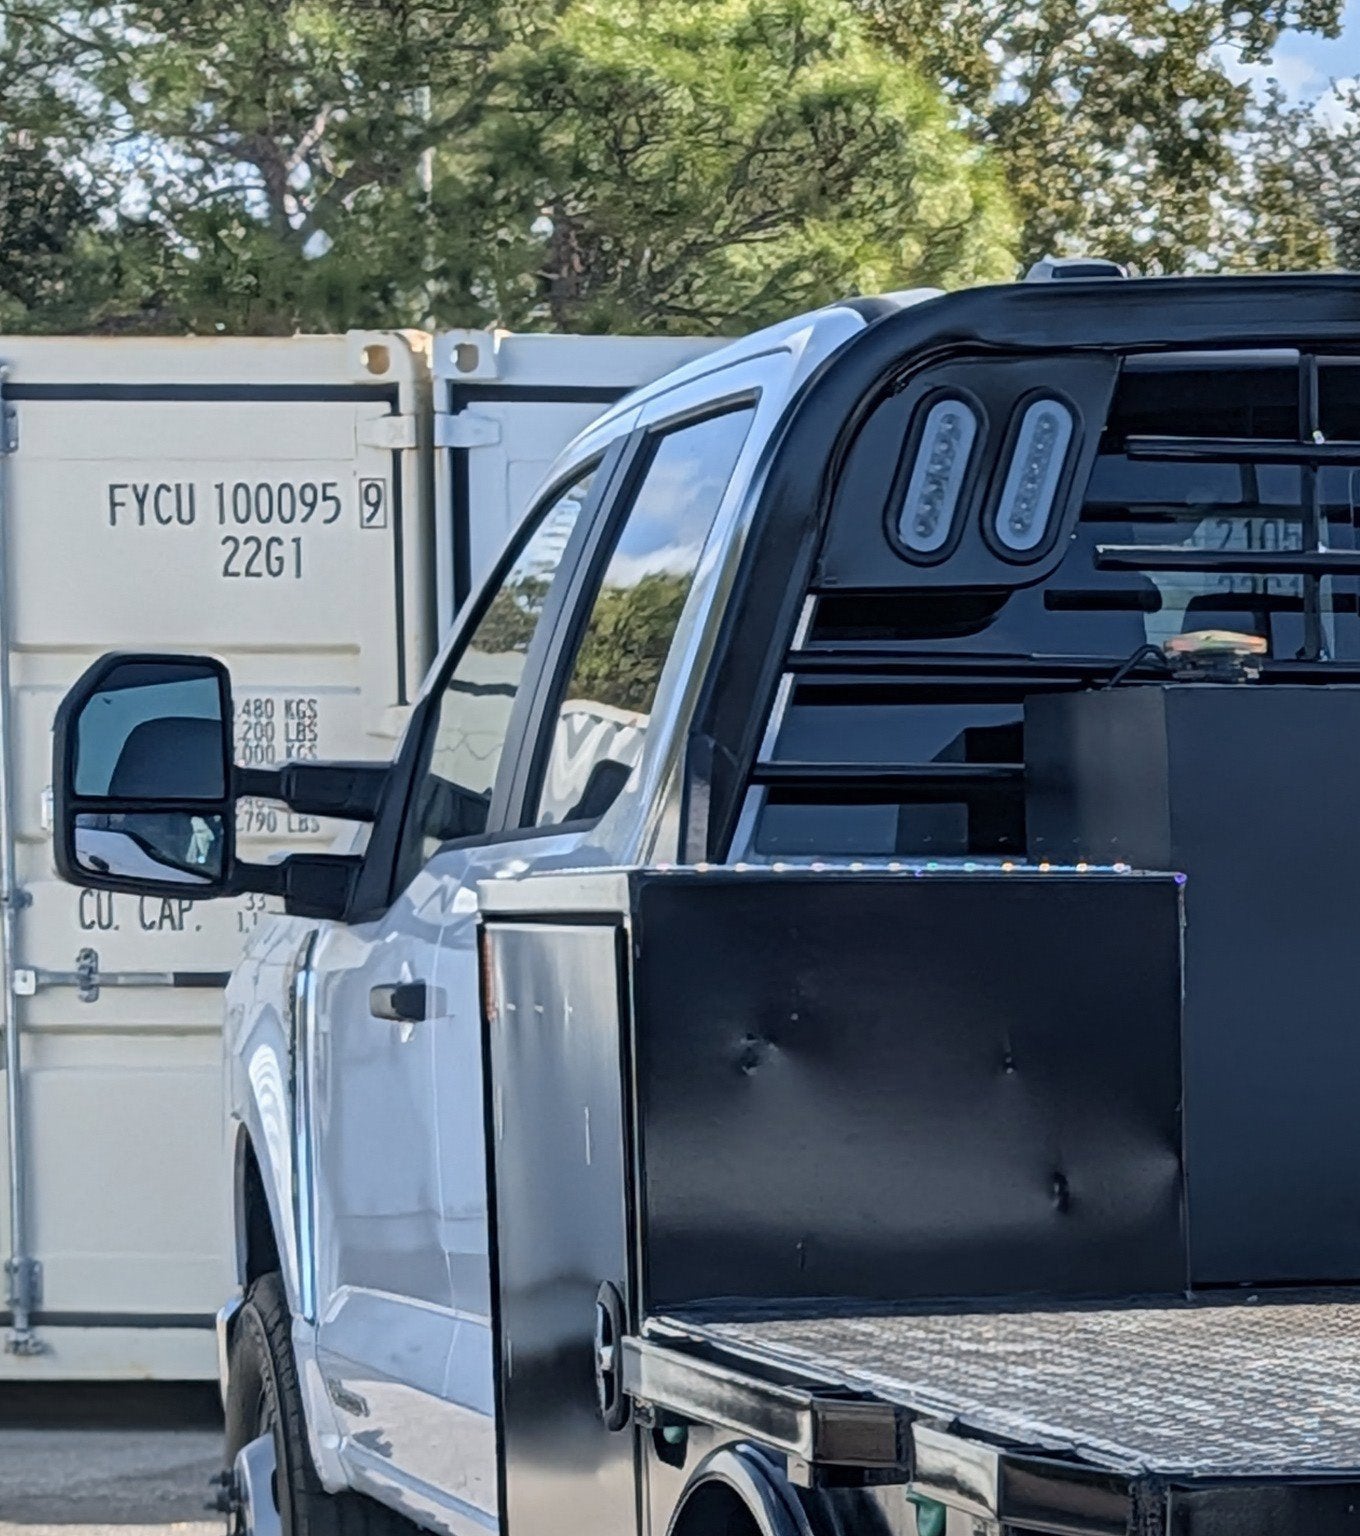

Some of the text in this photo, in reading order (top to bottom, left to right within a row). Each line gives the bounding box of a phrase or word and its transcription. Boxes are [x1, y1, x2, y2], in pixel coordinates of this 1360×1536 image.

[108, 482, 383, 526] FYCU 100095 9
[220, 535, 303, 579] 22G1
[284, 698, 319, 720] KGS
[284, 718, 319, 743] LBS
[78, 889, 120, 931] CU.
[137, 893, 203, 931] CAP.
